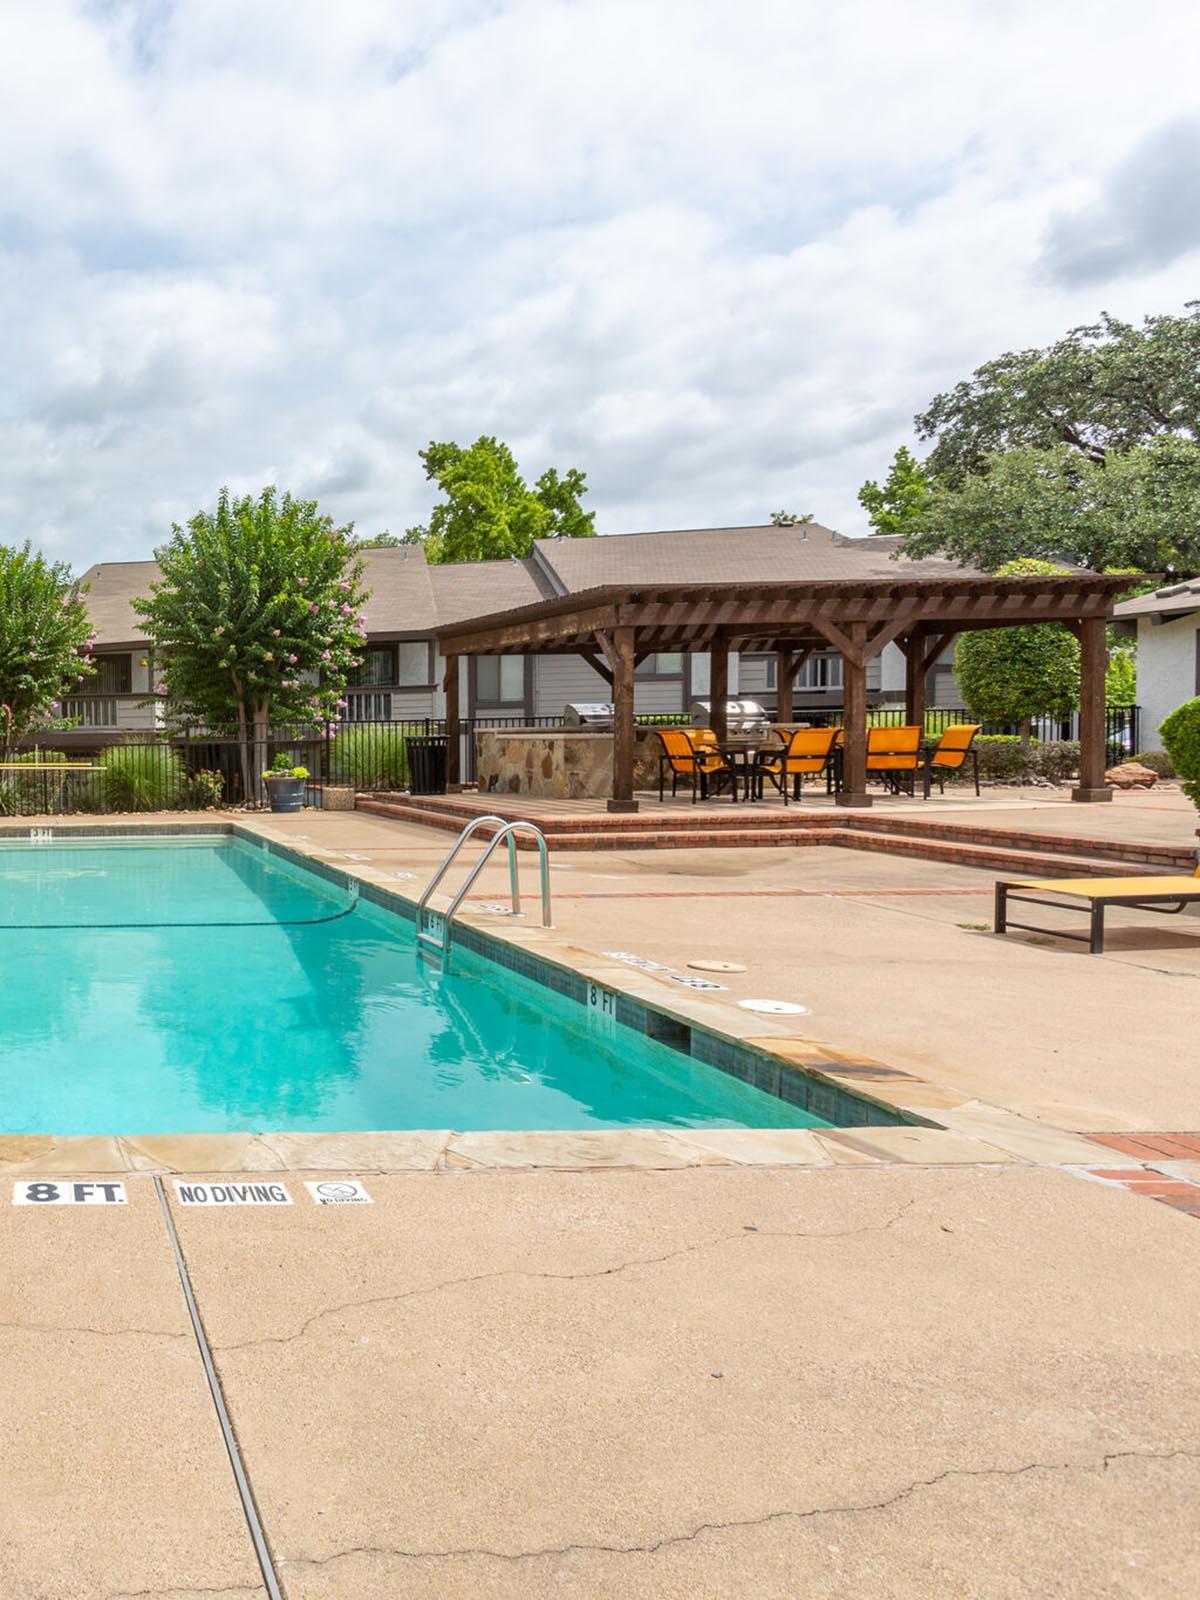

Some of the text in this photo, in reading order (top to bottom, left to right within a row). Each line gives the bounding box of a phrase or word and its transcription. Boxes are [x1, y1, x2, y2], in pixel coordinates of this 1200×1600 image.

[590, 985, 614, 1015] 8 FT
[25, 1183, 125, 1202] 8 FT.
[179, 1185, 288, 1203] NO DIVING
